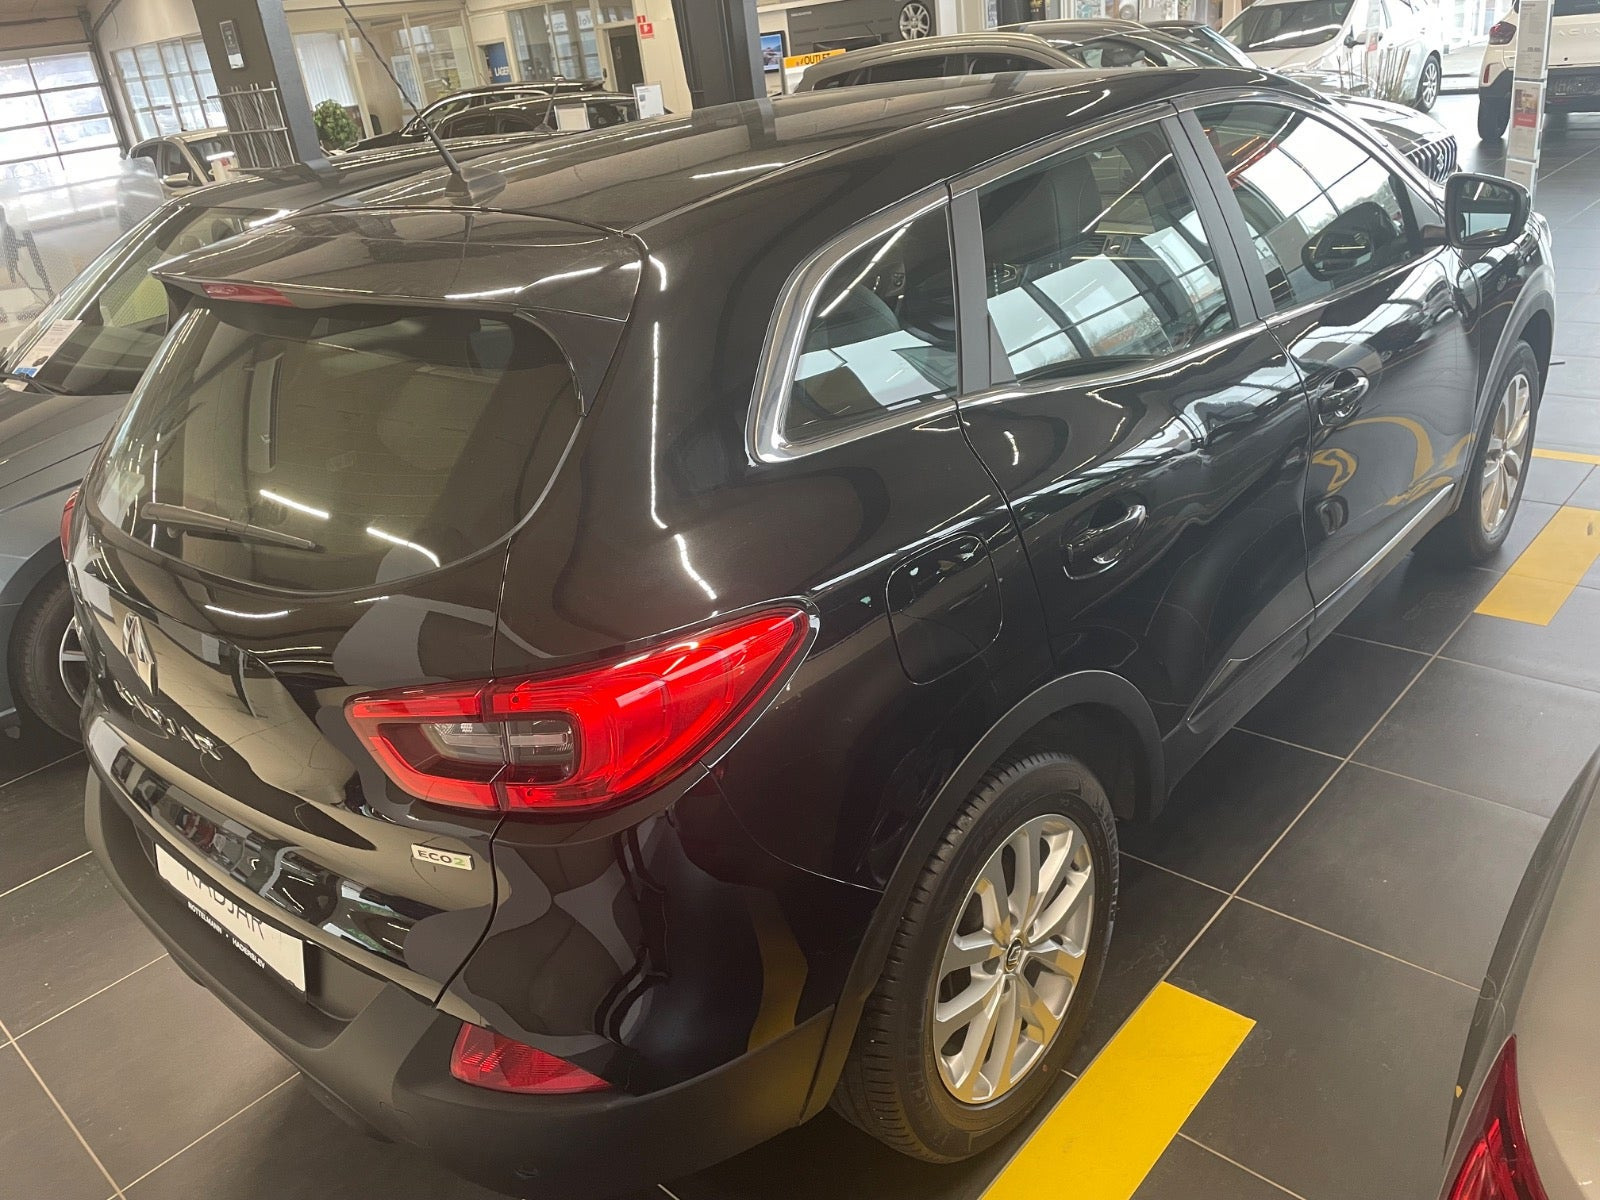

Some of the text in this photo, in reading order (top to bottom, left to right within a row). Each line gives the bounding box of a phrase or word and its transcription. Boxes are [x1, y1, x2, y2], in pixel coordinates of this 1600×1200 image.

[113, 679, 222, 761] KADJAR
[417, 849, 466, 866] ECO2
[231, 937, 266, 970] HADERSLEV
